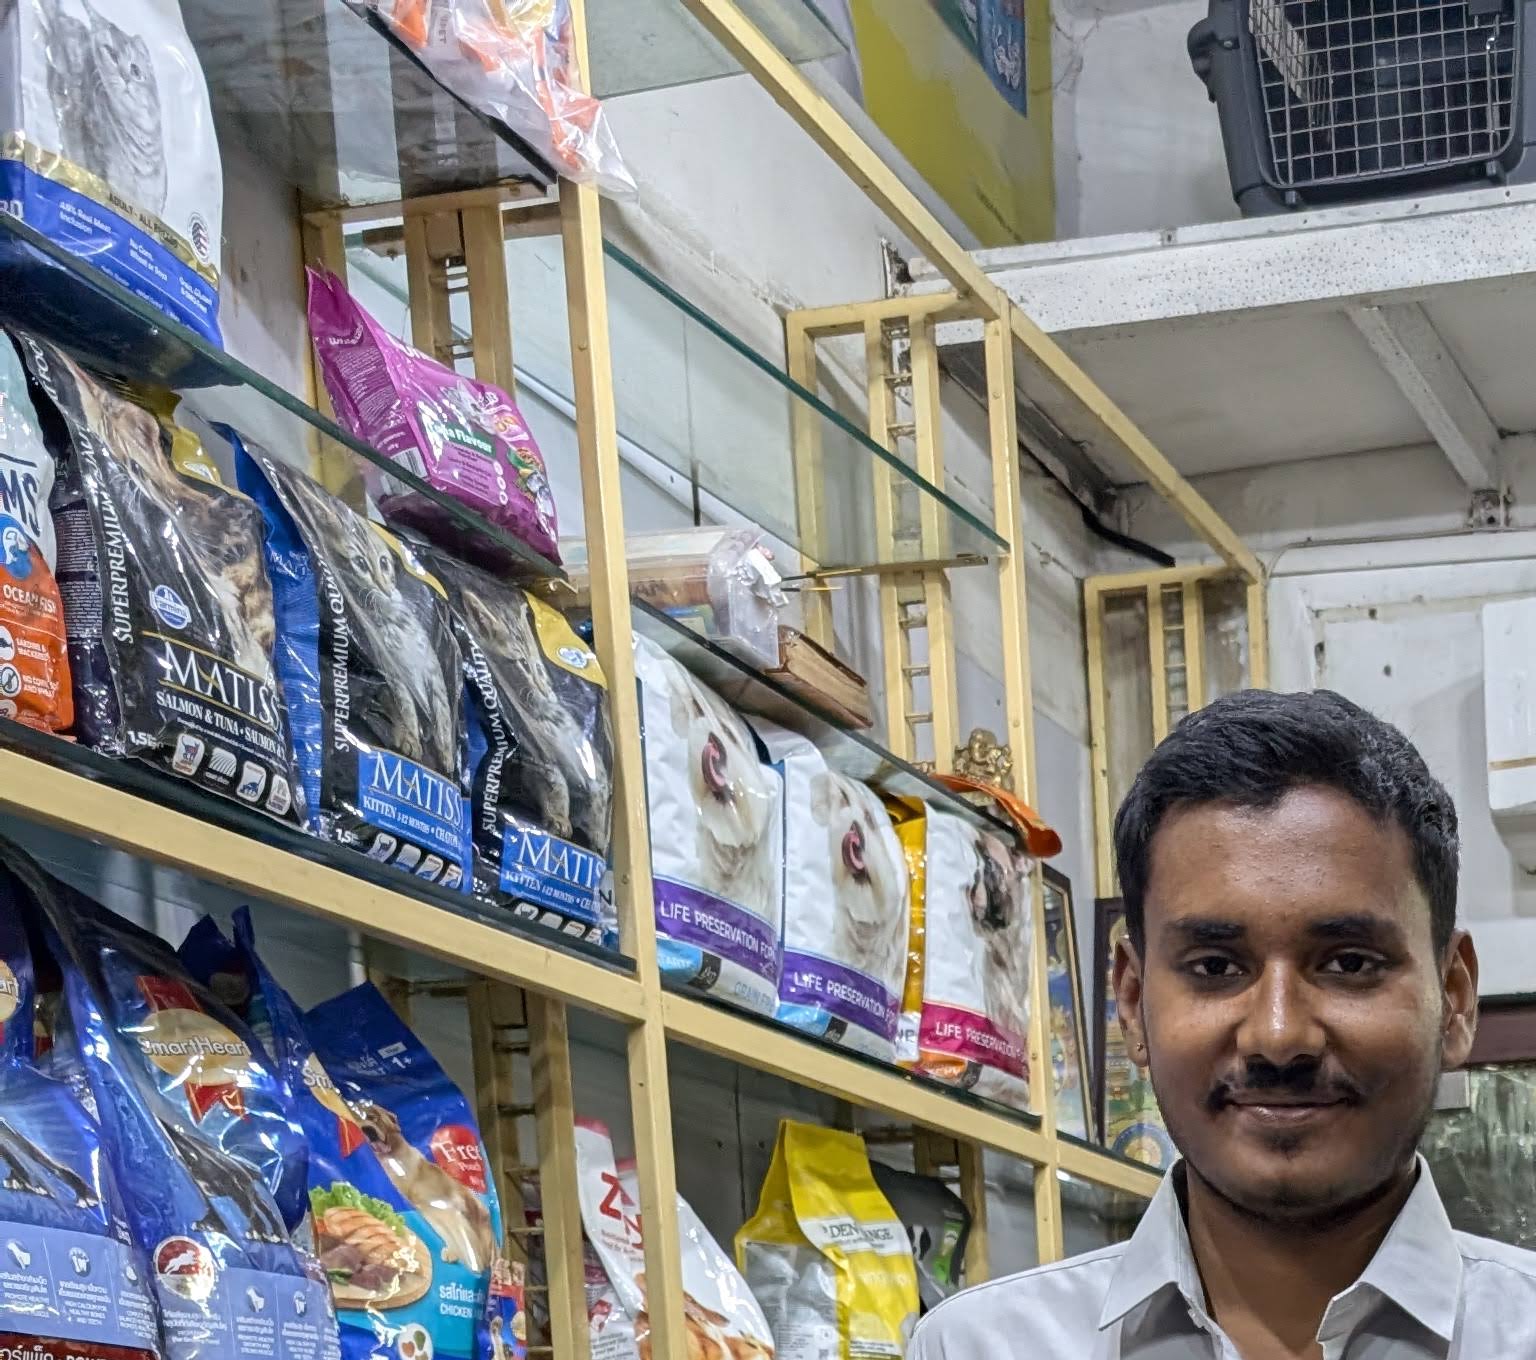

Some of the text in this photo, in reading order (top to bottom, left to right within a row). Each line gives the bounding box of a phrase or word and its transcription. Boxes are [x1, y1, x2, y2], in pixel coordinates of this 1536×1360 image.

[3, 583, 38, 604] OCEAN
[156, 690, 203, 723] SALMON
[213, 710, 240, 736] TUNA
[363, 795, 397, 820] KITTEN
[517, 832, 606, 889] MATIS
[660, 900, 760, 953] LIFE PRESERVATION
[793, 971, 886, 1019] LIFE PRESERVATION
[138, 1034, 251, 1059] SmartHeart
[935, 1021, 962, 1041] LIFE
